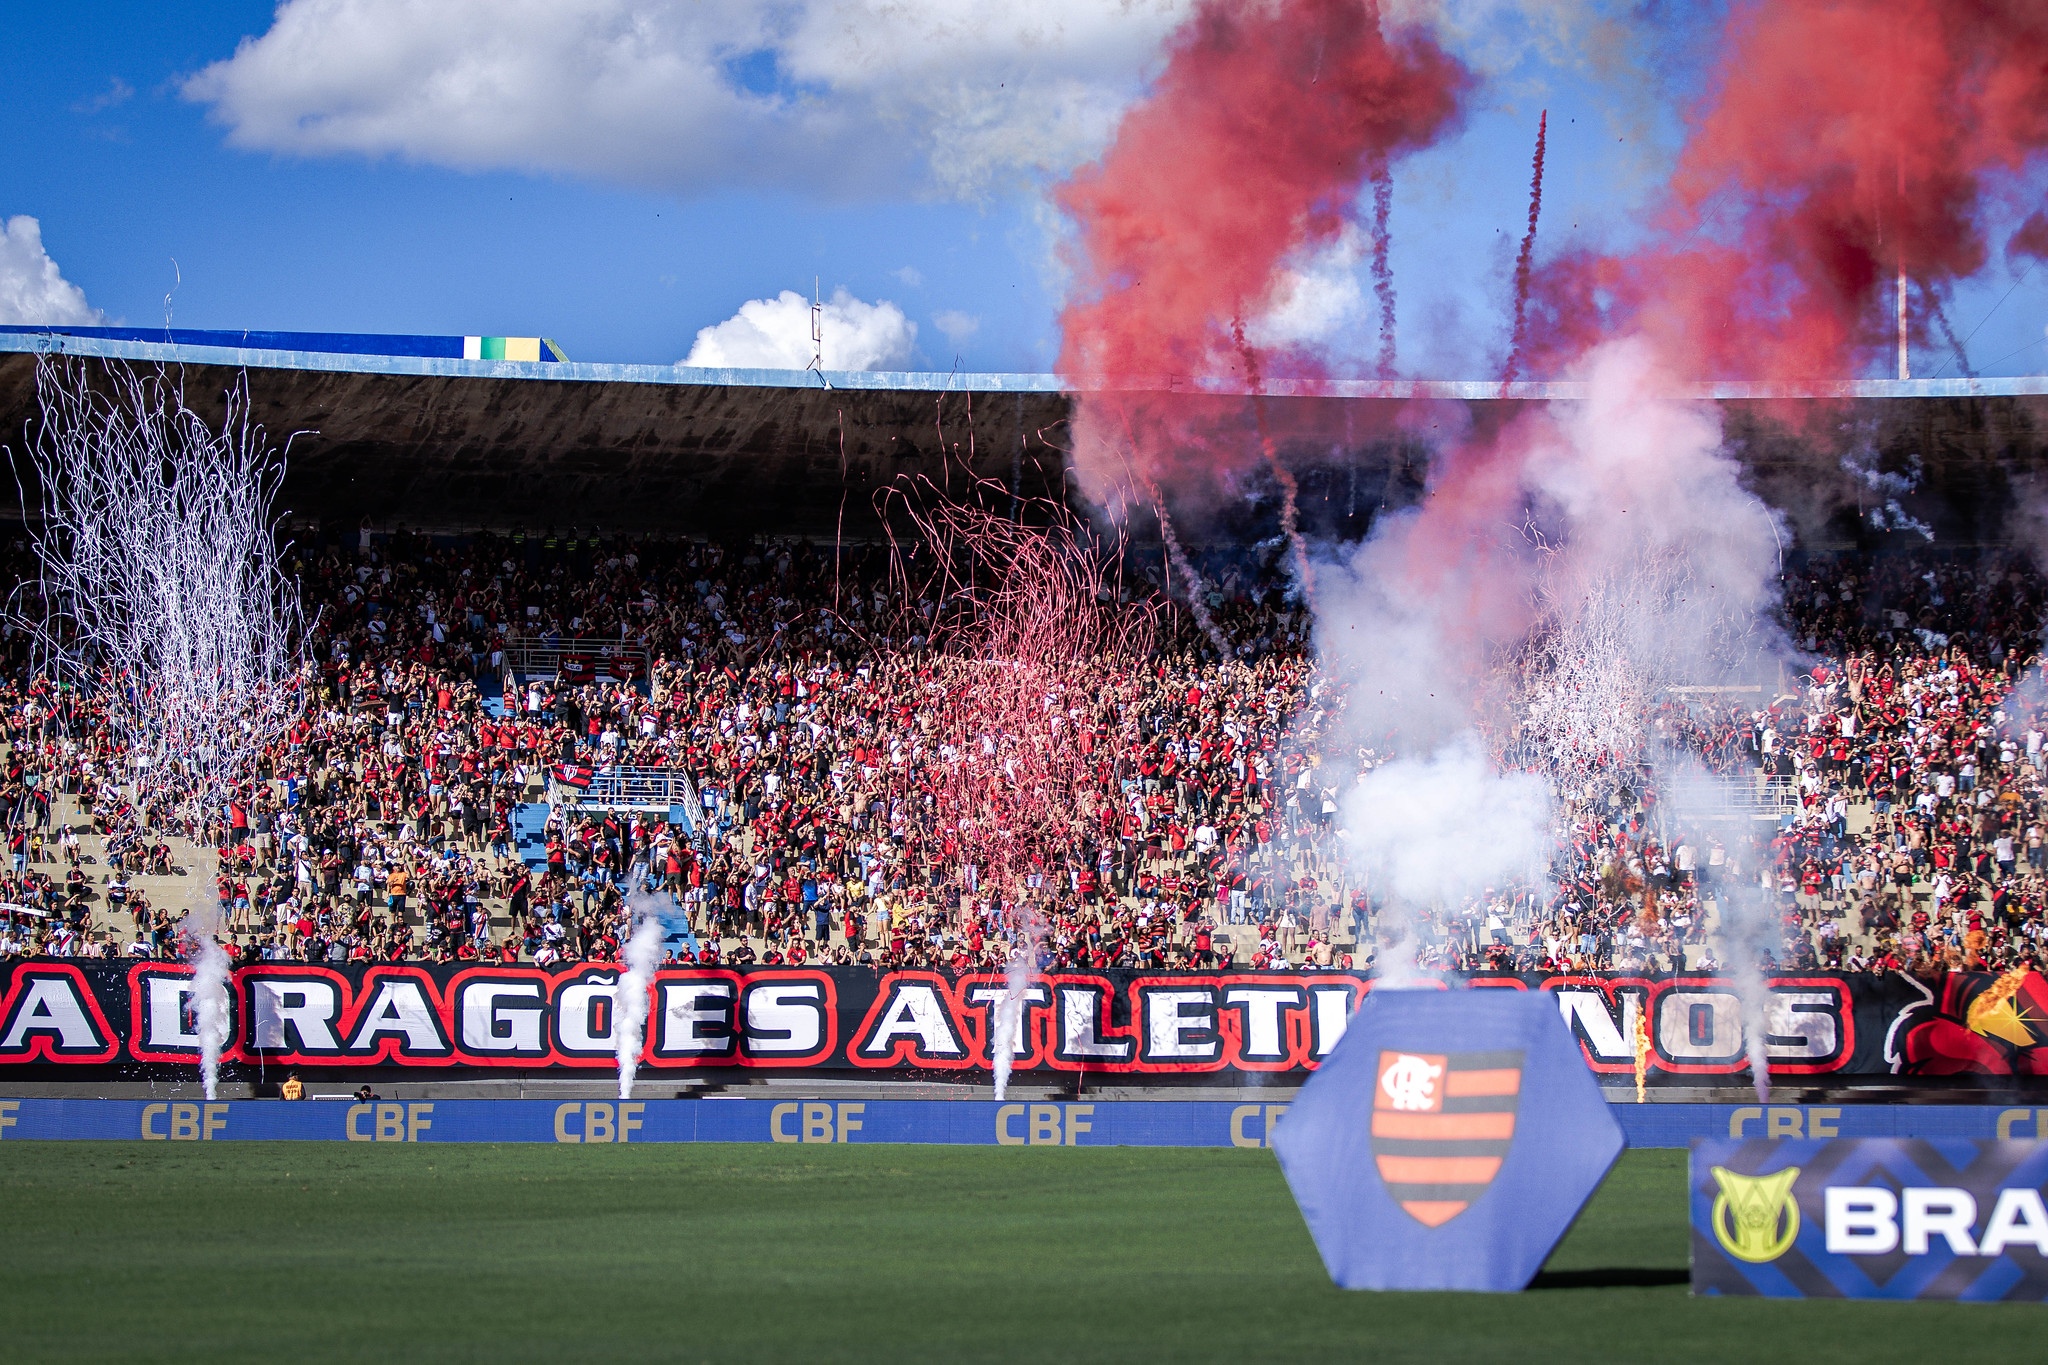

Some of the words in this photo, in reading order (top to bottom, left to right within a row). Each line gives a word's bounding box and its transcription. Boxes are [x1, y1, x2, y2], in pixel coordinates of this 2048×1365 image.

[1, 978, 100, 1047] A
[147, 974, 820, 1051] DRAGÕES
[865, 985, 1837, 1058] ATLETINOS
[141, 1103, 229, 1140] CBF
[346, 1103, 435, 1142] CBF
[554, 1103, 645, 1143] CBF
[770, 1103, 865, 1144] CBF
[995, 1104, 1095, 1146] CBF
[1729, 1107, 1842, 1139] CBF
[1825, 1186, 2048, 1256] BRA
